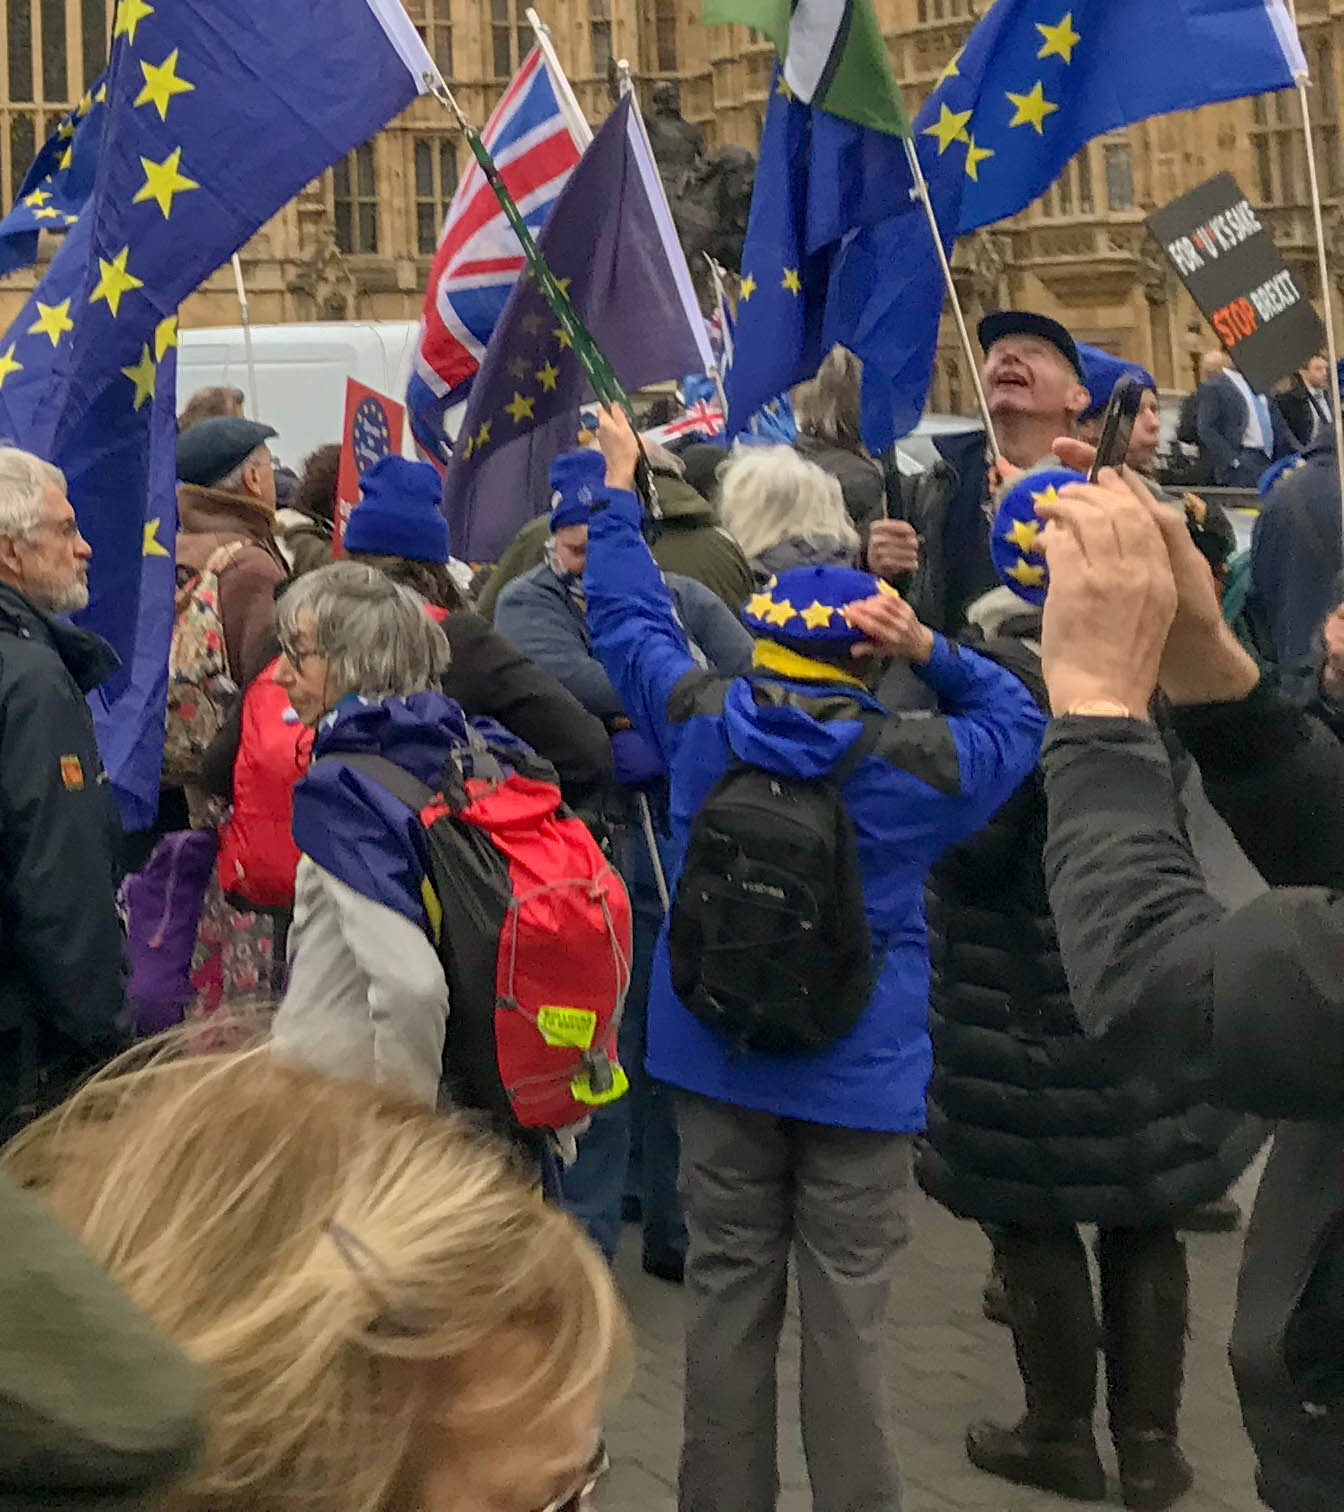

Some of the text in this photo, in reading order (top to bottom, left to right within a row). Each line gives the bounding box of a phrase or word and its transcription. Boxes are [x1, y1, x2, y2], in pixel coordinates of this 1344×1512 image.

[1167, 236, 1205, 276] FOR
[1225, 200, 1262, 242] SAKE
[1212, 268, 1302, 348] STOP BREXIT
